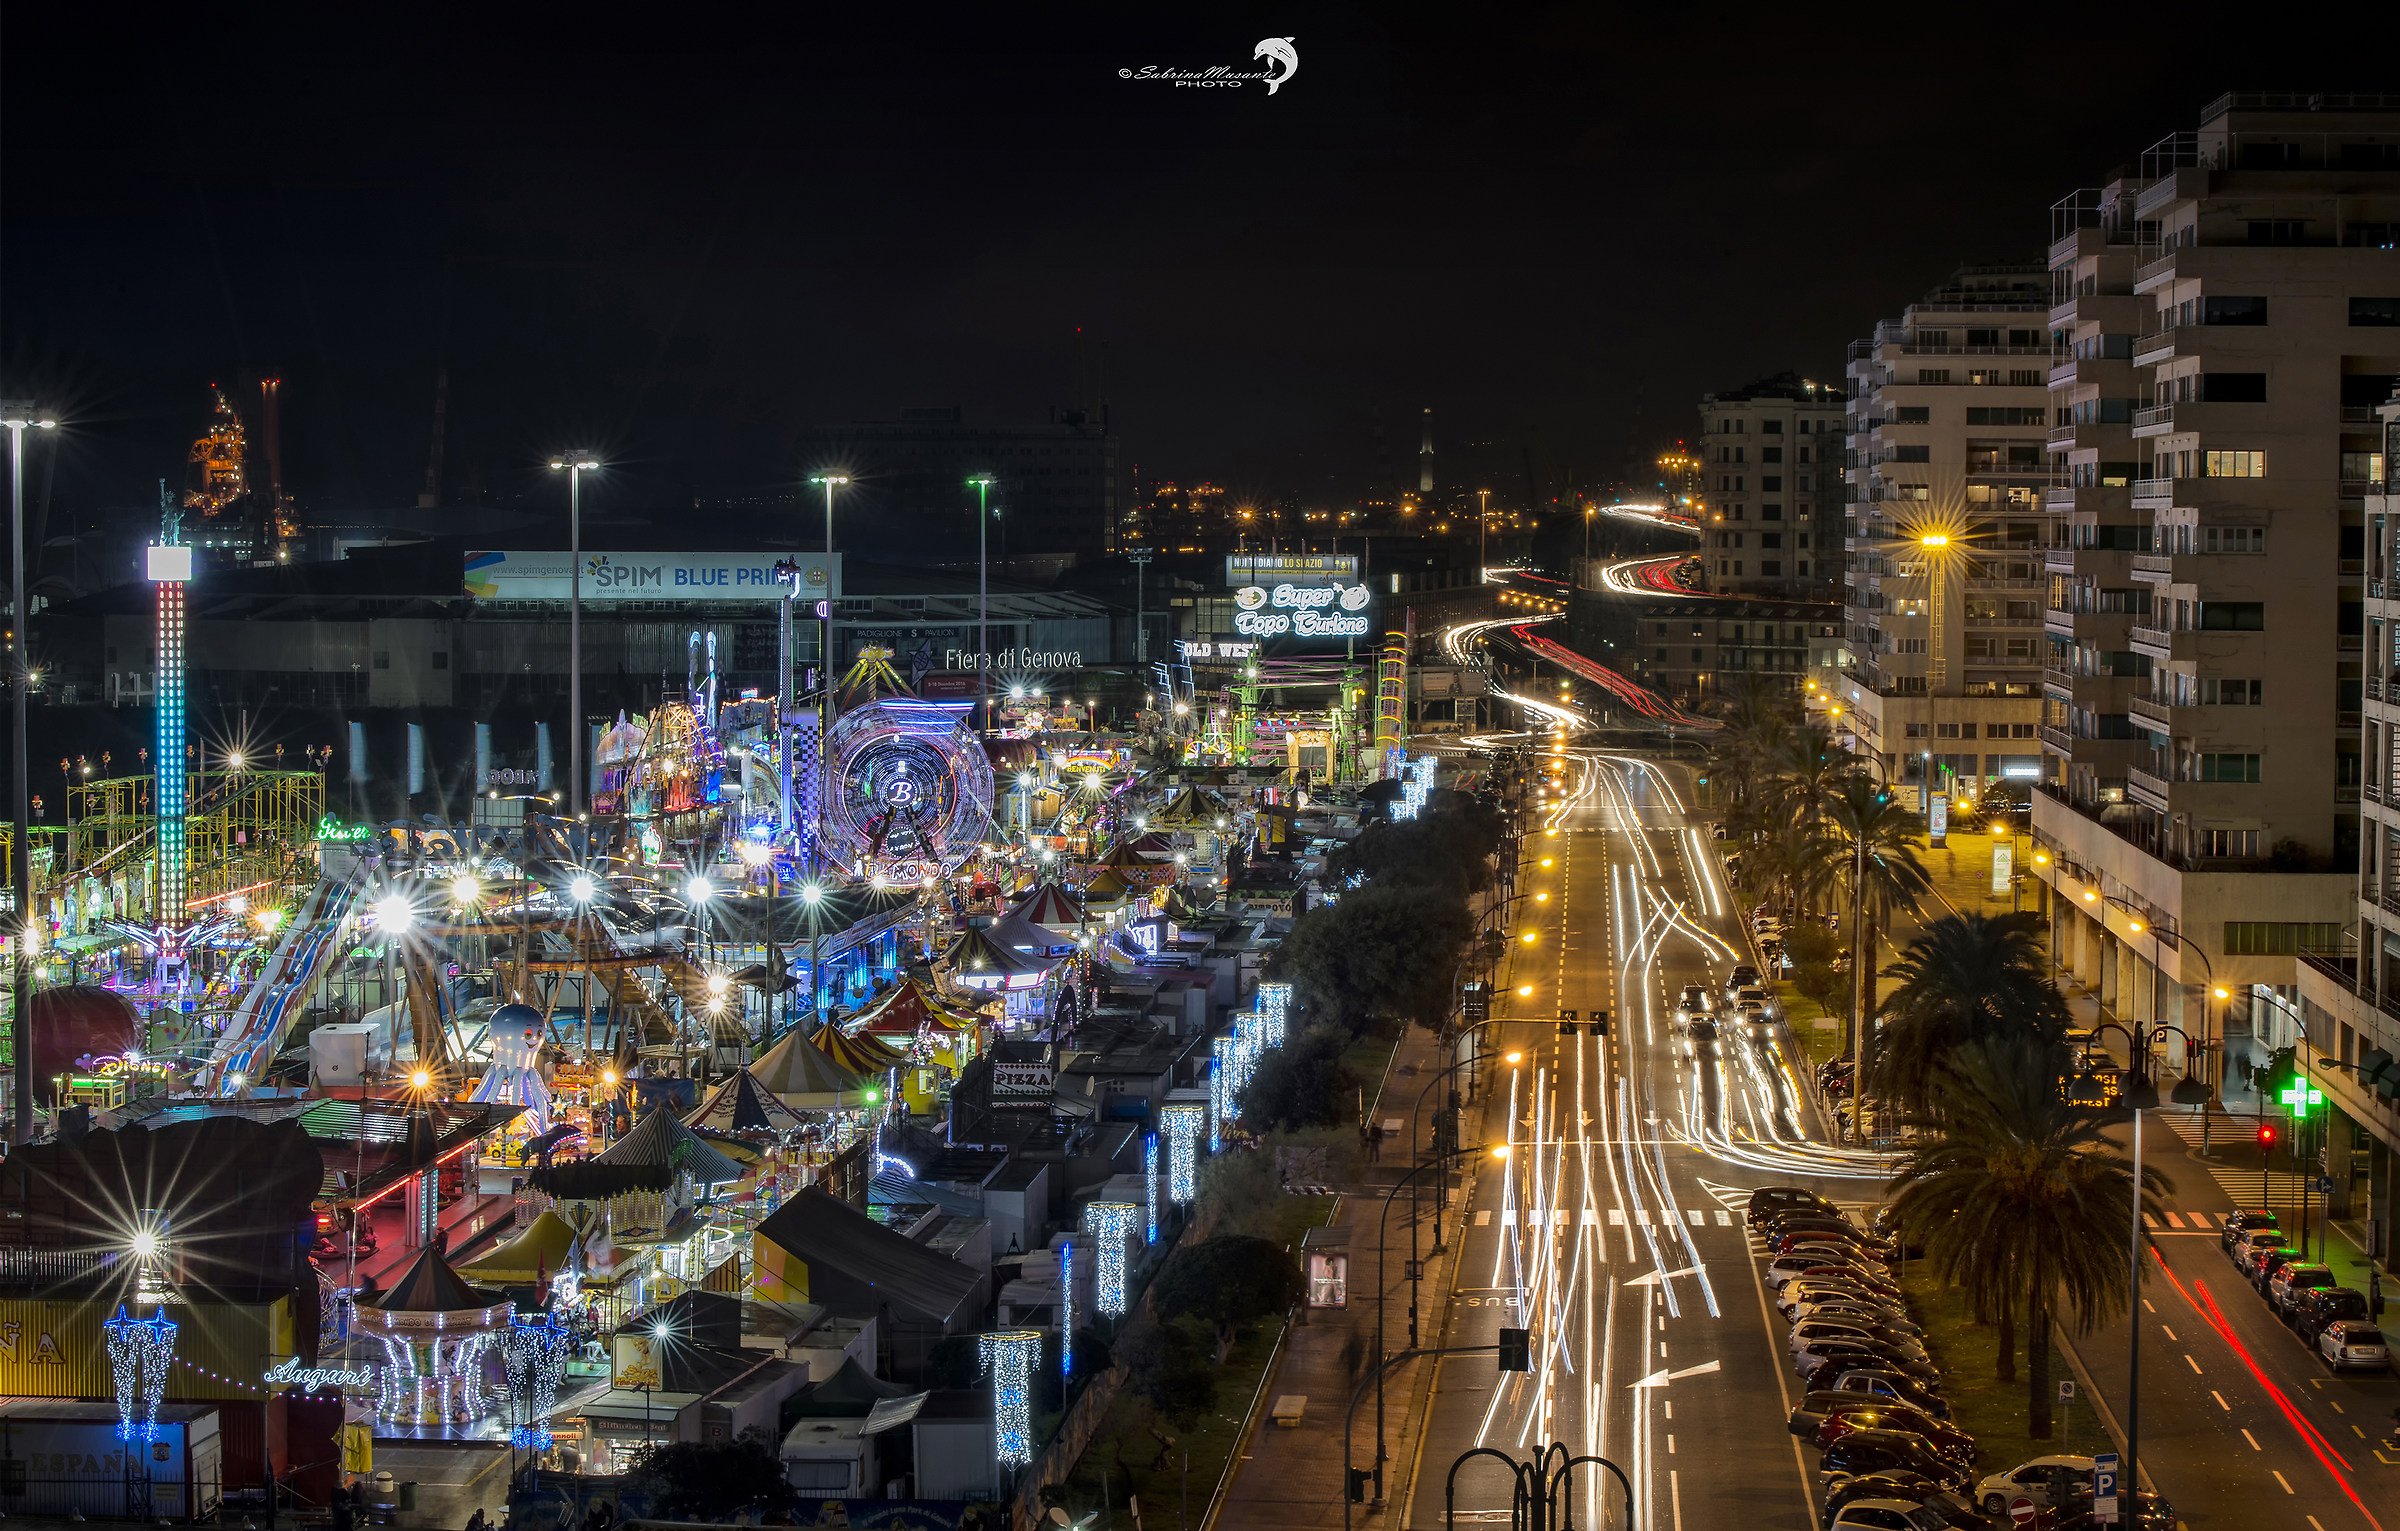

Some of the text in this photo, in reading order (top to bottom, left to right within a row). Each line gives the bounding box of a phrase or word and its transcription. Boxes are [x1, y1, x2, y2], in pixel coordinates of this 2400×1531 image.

[493, 565, 584, 576] www.spimgenovait
[1284, 558, 1294, 569] LO
[596, 565, 662, 587] SPIM
[674, 568, 729, 586] BLUE
[1272, 584, 1334, 610] Super
[1235, 610, 1368, 637] Topo Burlone
[857, 629, 955, 638] PADIGLIONE S PAVILION
[946, 646, 1083, 670] Fiera di Genova
[1184, 642, 1212, 657] OLD
[890, 782, 913, 802] B
[2156, 1030, 2166, 1042] P
[996, 1073, 1050, 1086] PIZZA
[1467, 1297, 1519, 1307] BUS
[264, 1356, 375, 1392] Auguri
[552, 1432, 577, 1440] annoli
[32, 1449, 142, 1474] ESPAÑA
[2099, 1474, 2113, 1496] P
